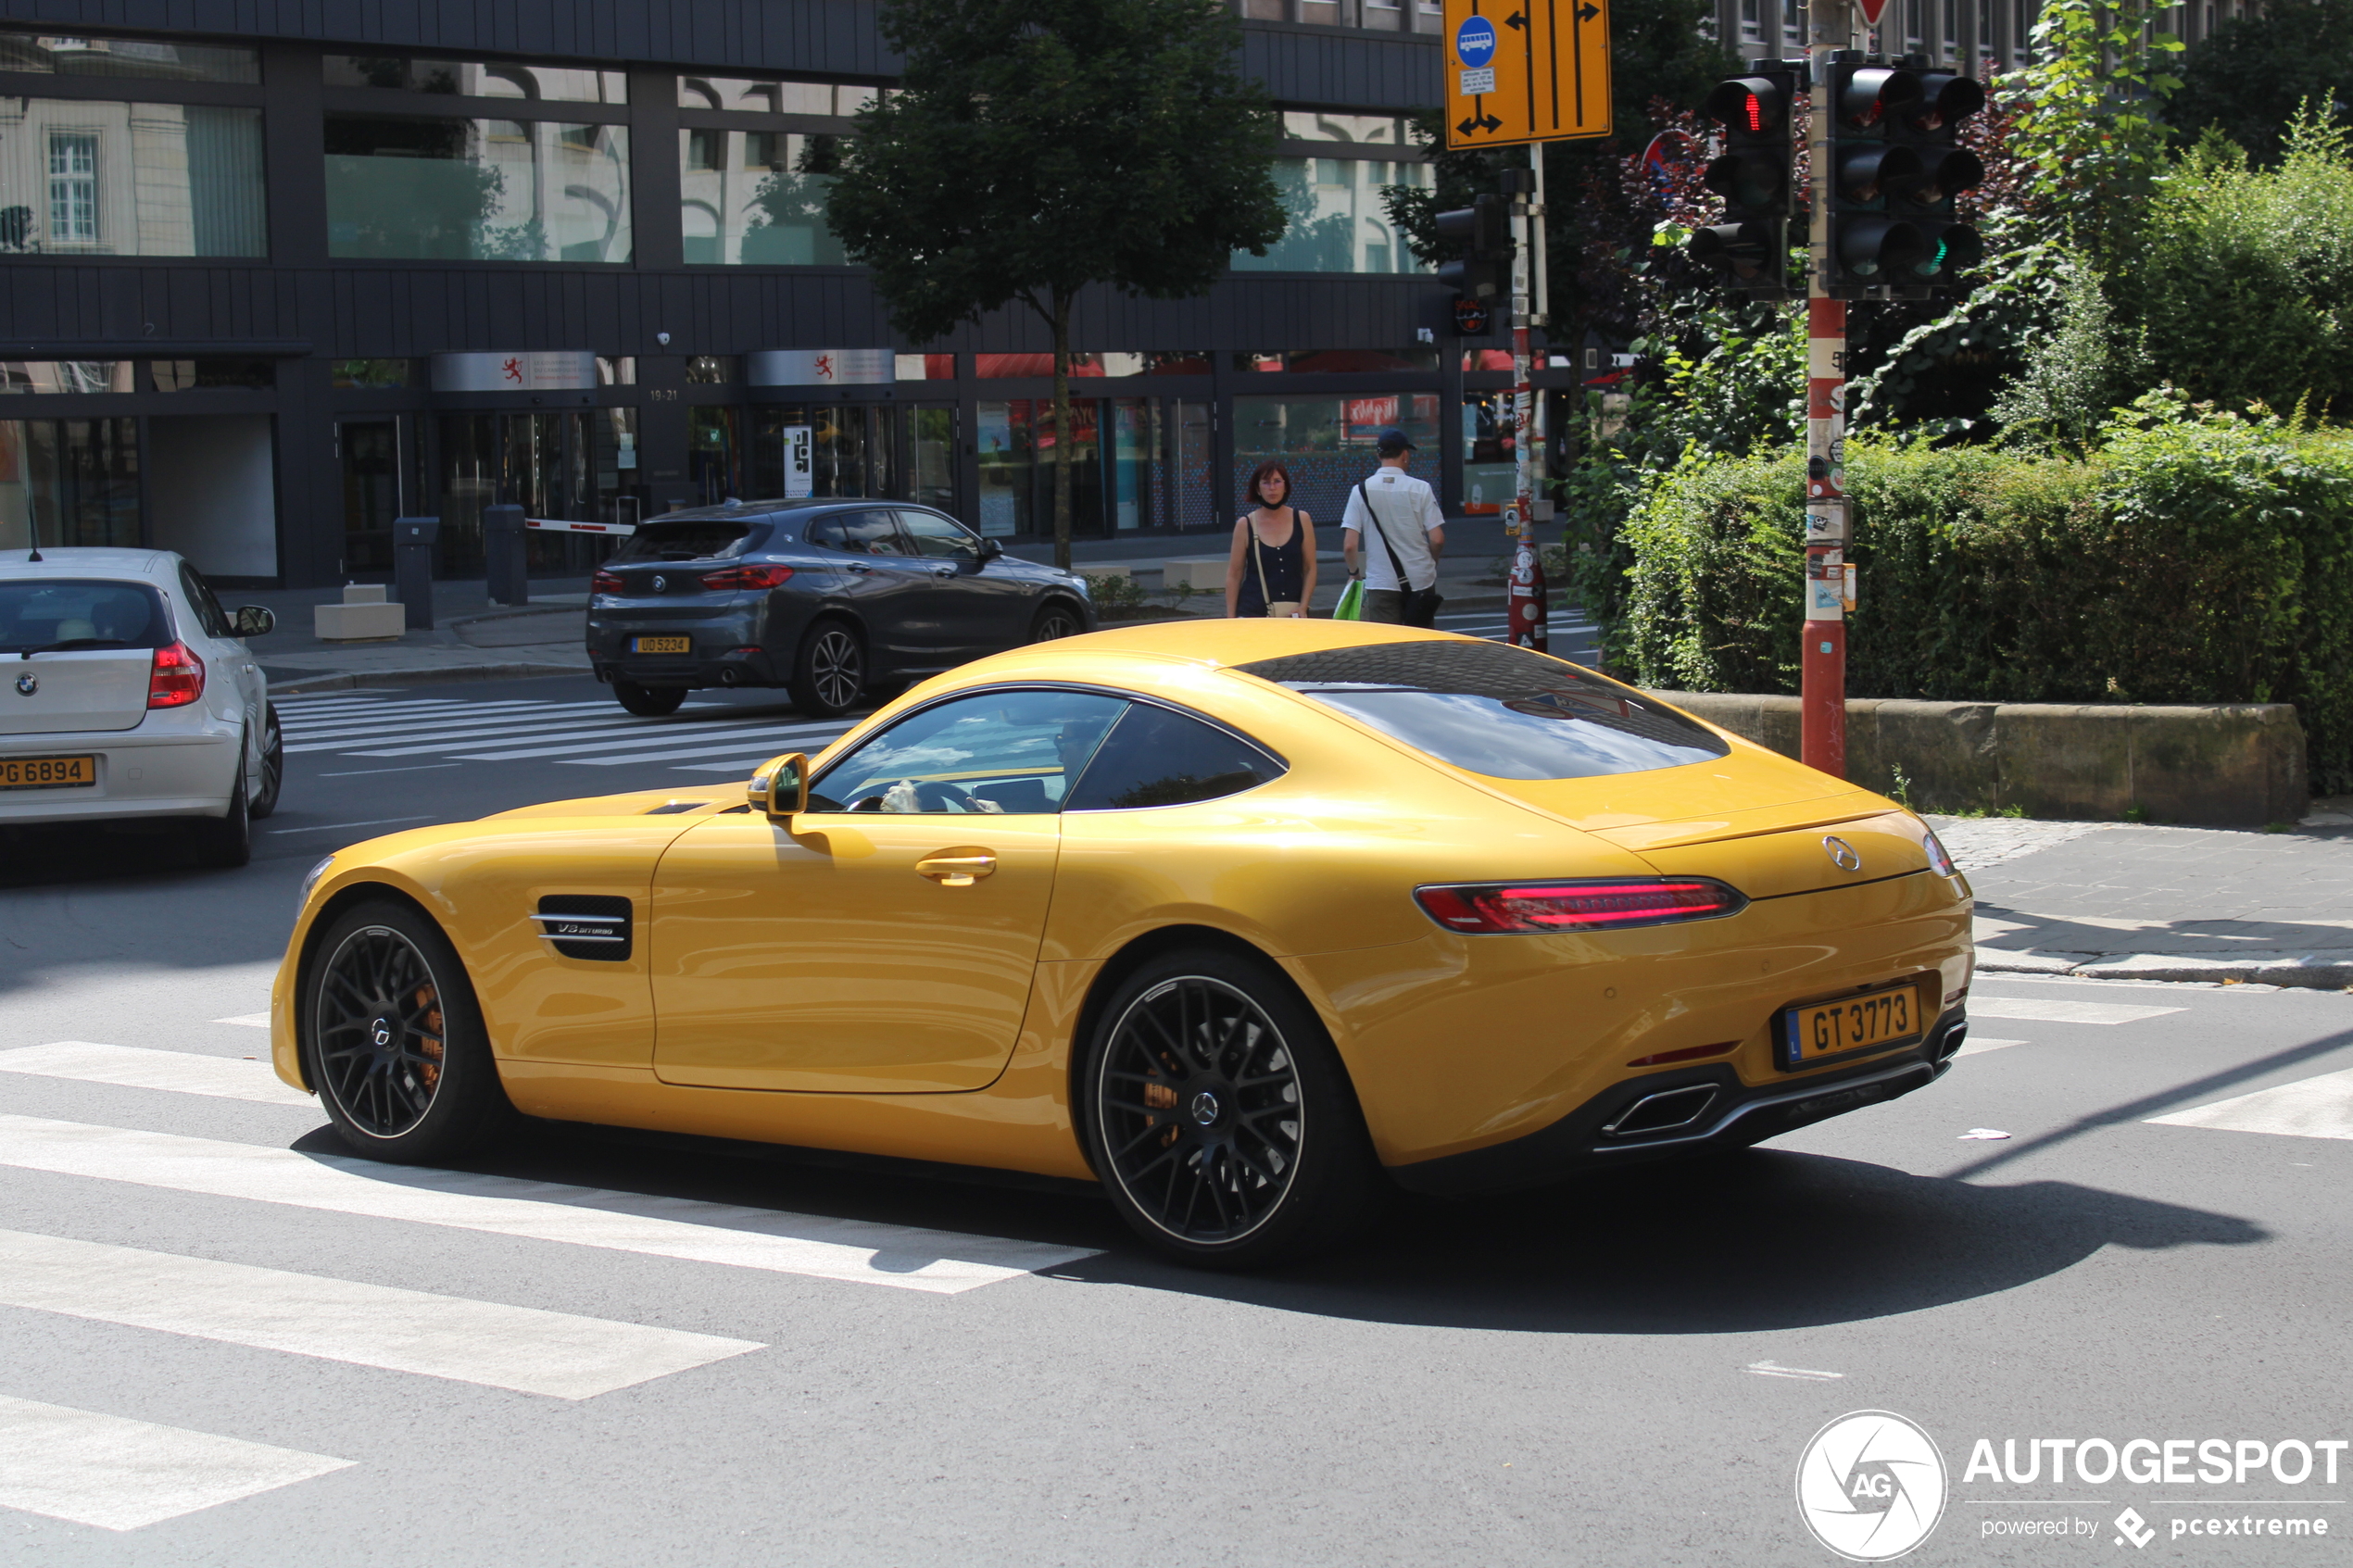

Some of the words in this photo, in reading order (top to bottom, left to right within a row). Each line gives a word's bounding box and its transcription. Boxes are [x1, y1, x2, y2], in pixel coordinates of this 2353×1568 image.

[650, 389, 677, 401] 19-21
[657, 638, 685, 651] 5234
[24, 759, 82, 782] 6894
[1791, 1041, 1798, 1055] L
[1813, 1007, 1843, 1050] GT
[1849, 993, 1908, 1043] 3773
